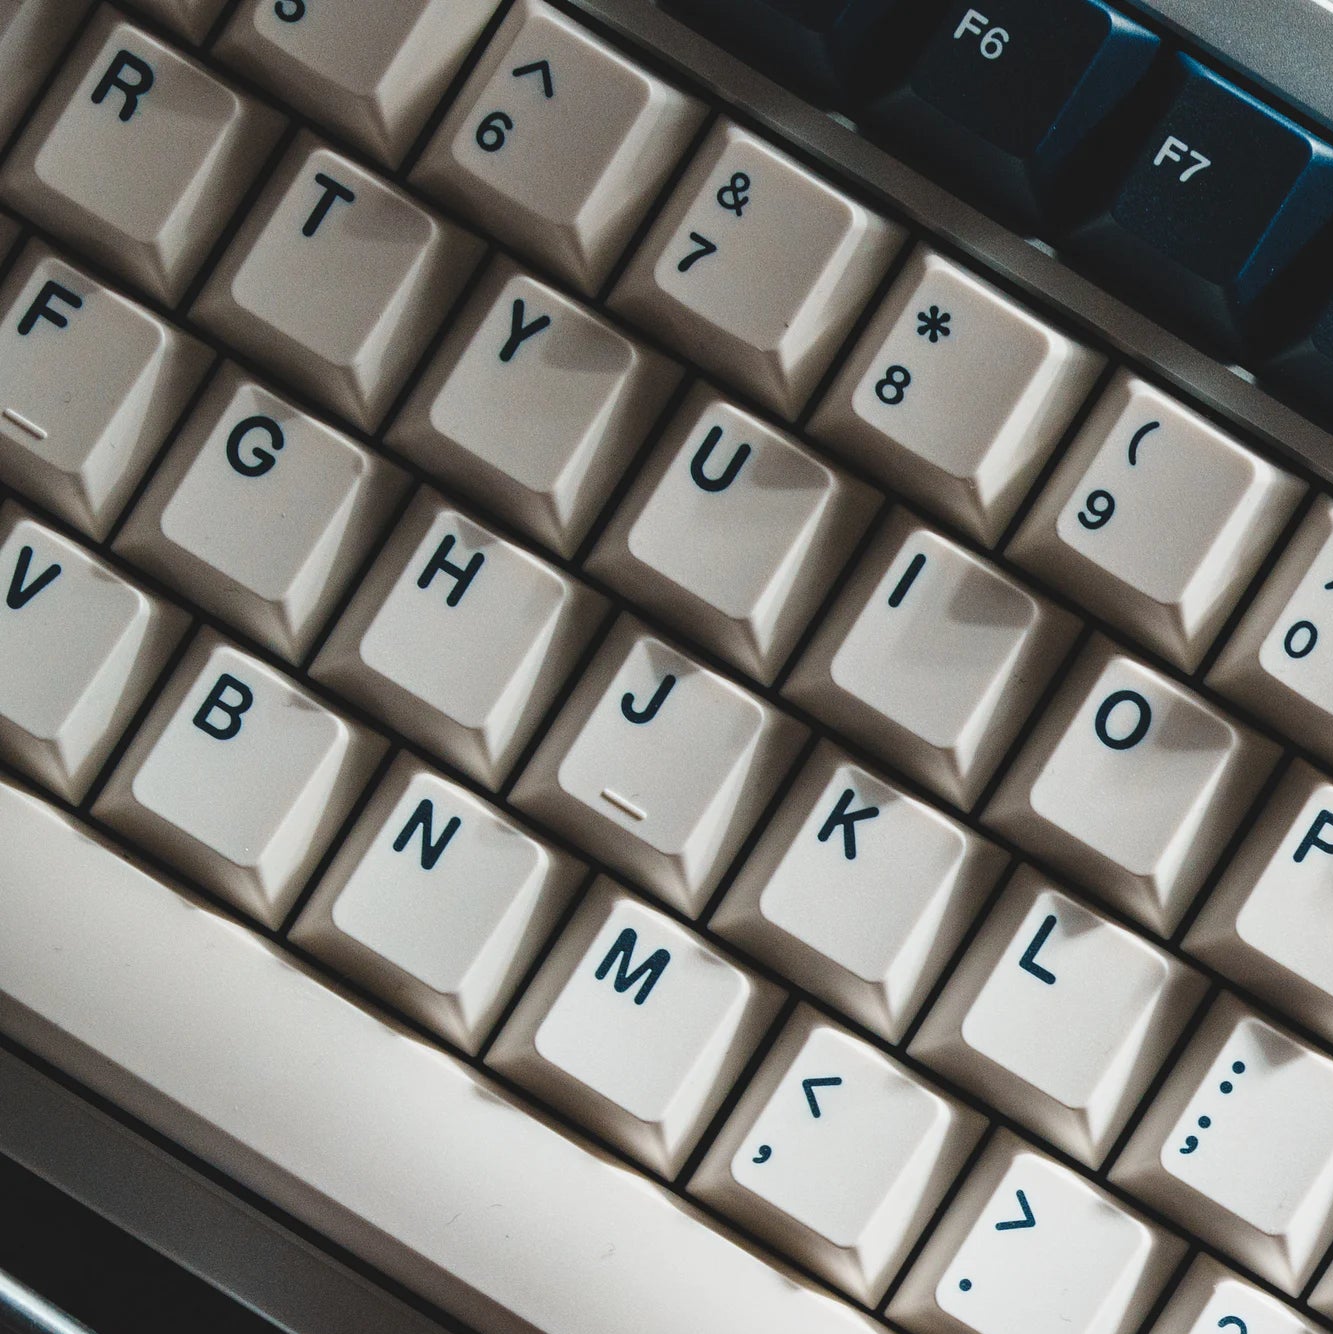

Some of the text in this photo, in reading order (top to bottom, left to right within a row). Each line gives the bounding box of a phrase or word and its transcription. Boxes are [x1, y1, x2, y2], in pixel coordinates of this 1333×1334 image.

[953, 8, 1010, 60] F6
[90, 49, 157, 123] R
[475, 111, 514, 153] 6
[1153, 135, 1212, 183] F7
[301, 172, 357, 238] T
[716, 171, 751, 217] &
[677, 231, 718, 273] 7
[16, 279, 83, 336] F
[498, 298, 551, 363] Y
[874, 364, 912, 406] 8
[225, 415, 285, 478] G
[690, 425, 752, 493] U
[1128, 420, 1161, 466] (
[1077, 489, 1116, 530] 9
[5, 545, 62, 610] V
[416, 534, 486, 608] H
[887, 553, 927, 609] I
[192, 673, 254, 741] B
[621, 674, 676, 724] J
[1094, 689, 1153, 751] O
[392, 798, 462, 871] N
[817, 788, 880, 861] K
[594, 927, 671, 1006] M
[1018, 914, 1058, 985] L
[1219, 1060, 1246, 1095] :
[1179, 1115, 1212, 1155] ;
